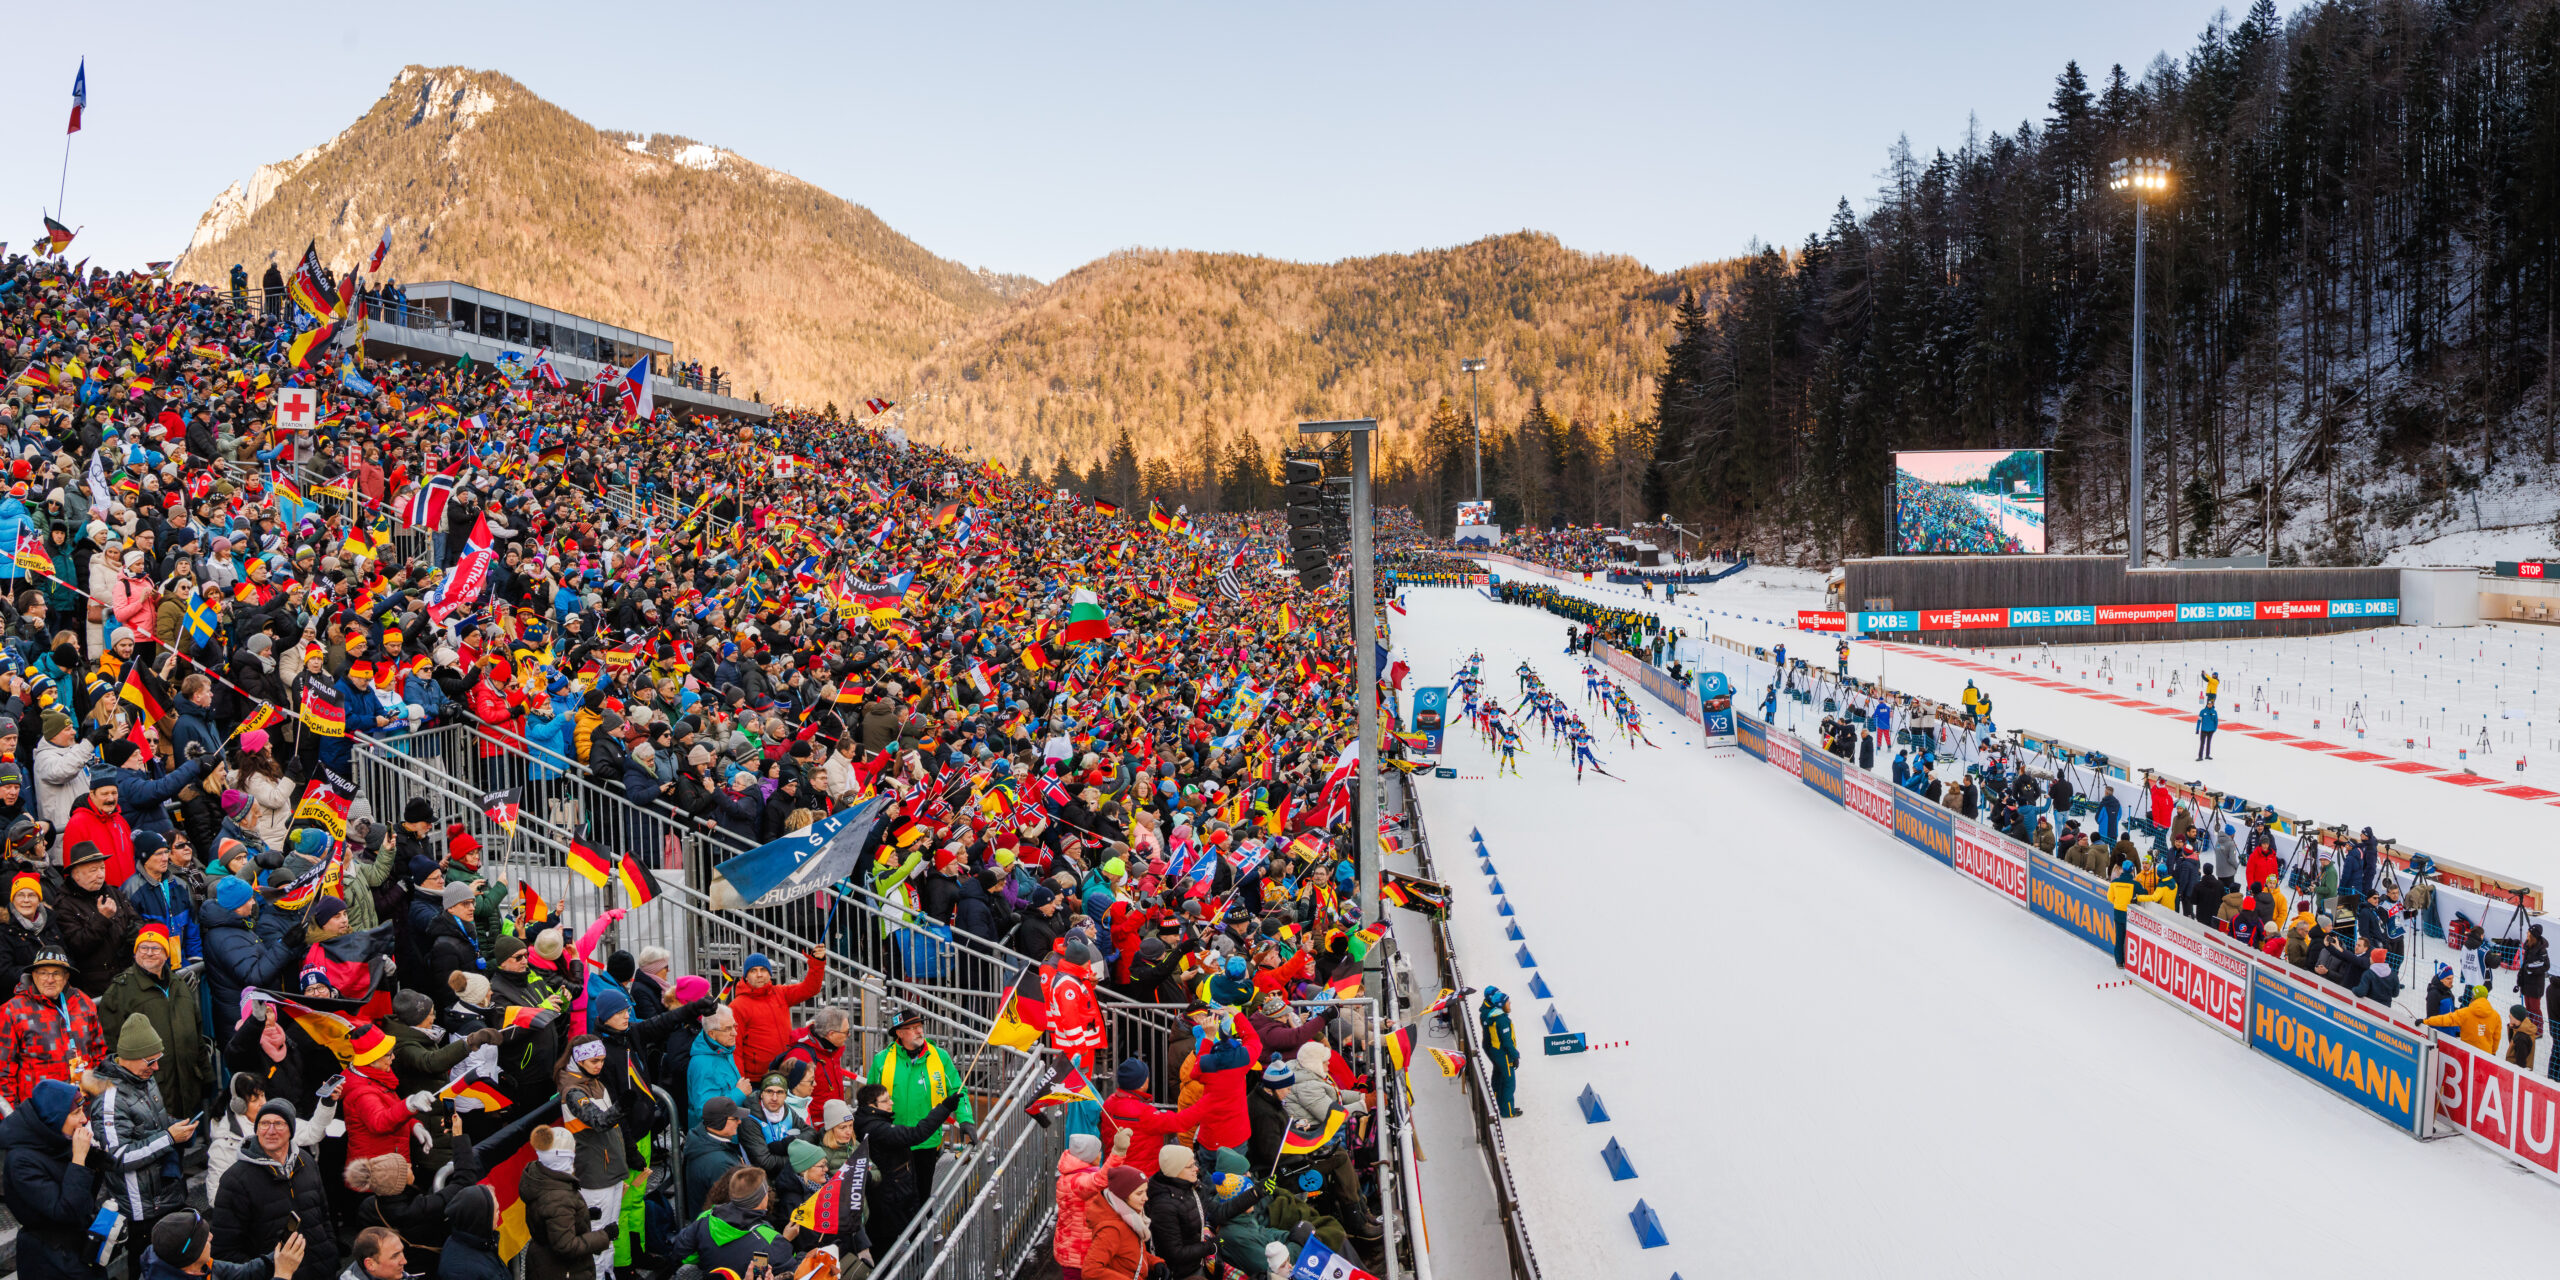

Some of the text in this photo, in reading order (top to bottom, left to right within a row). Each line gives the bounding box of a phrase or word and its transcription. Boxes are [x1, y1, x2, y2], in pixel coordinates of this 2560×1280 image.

[308, 250, 331, 292] BIATHLON
[2521, 564, 2541, 576] STOP
[2013, 610, 2041, 623] DKB
[2054, 609, 2082, 622] DKB
[2098, 607, 2174, 621] Wärmepumpen
[2181, 606, 2206, 619] DKB
[2218, 605, 2243, 618] DKB
[2263, 602, 2321, 618] VIESSMANN
[2332, 602, 2355, 615] DKB
[2365, 602, 2388, 614] DKB
[1798, 613, 1845, 628] VIESSMANN
[1868, 615, 1898, 628] DKB
[1929, 610, 1999, 629] VIESSMANN
[1711, 717, 1728, 730] X3
[1767, 742, 1802, 777] BAUHAUS
[1803, 760, 1842, 799] HÖRMANN
[1845, 782, 1892, 825] BAUHAUS
[1895, 808, 1952, 858] HÖRMANN
[1956, 841, 2026, 896] BAUHAUS
[2031, 877, 2117, 946] HÖRMANN
[2167, 928, 2202, 956] BAUHAUS
[2208, 946, 2247, 977] BAUHAUS
[2126, 936, 2243, 1024] BAUHAUS
[2258, 974, 2413, 1055] HÖRMANN HÖRMANN HÖRMANN HÖRMANN
[2255, 1002, 2411, 1114] HÖRMANN
[850, 1157, 867, 1211] BIATHLON
